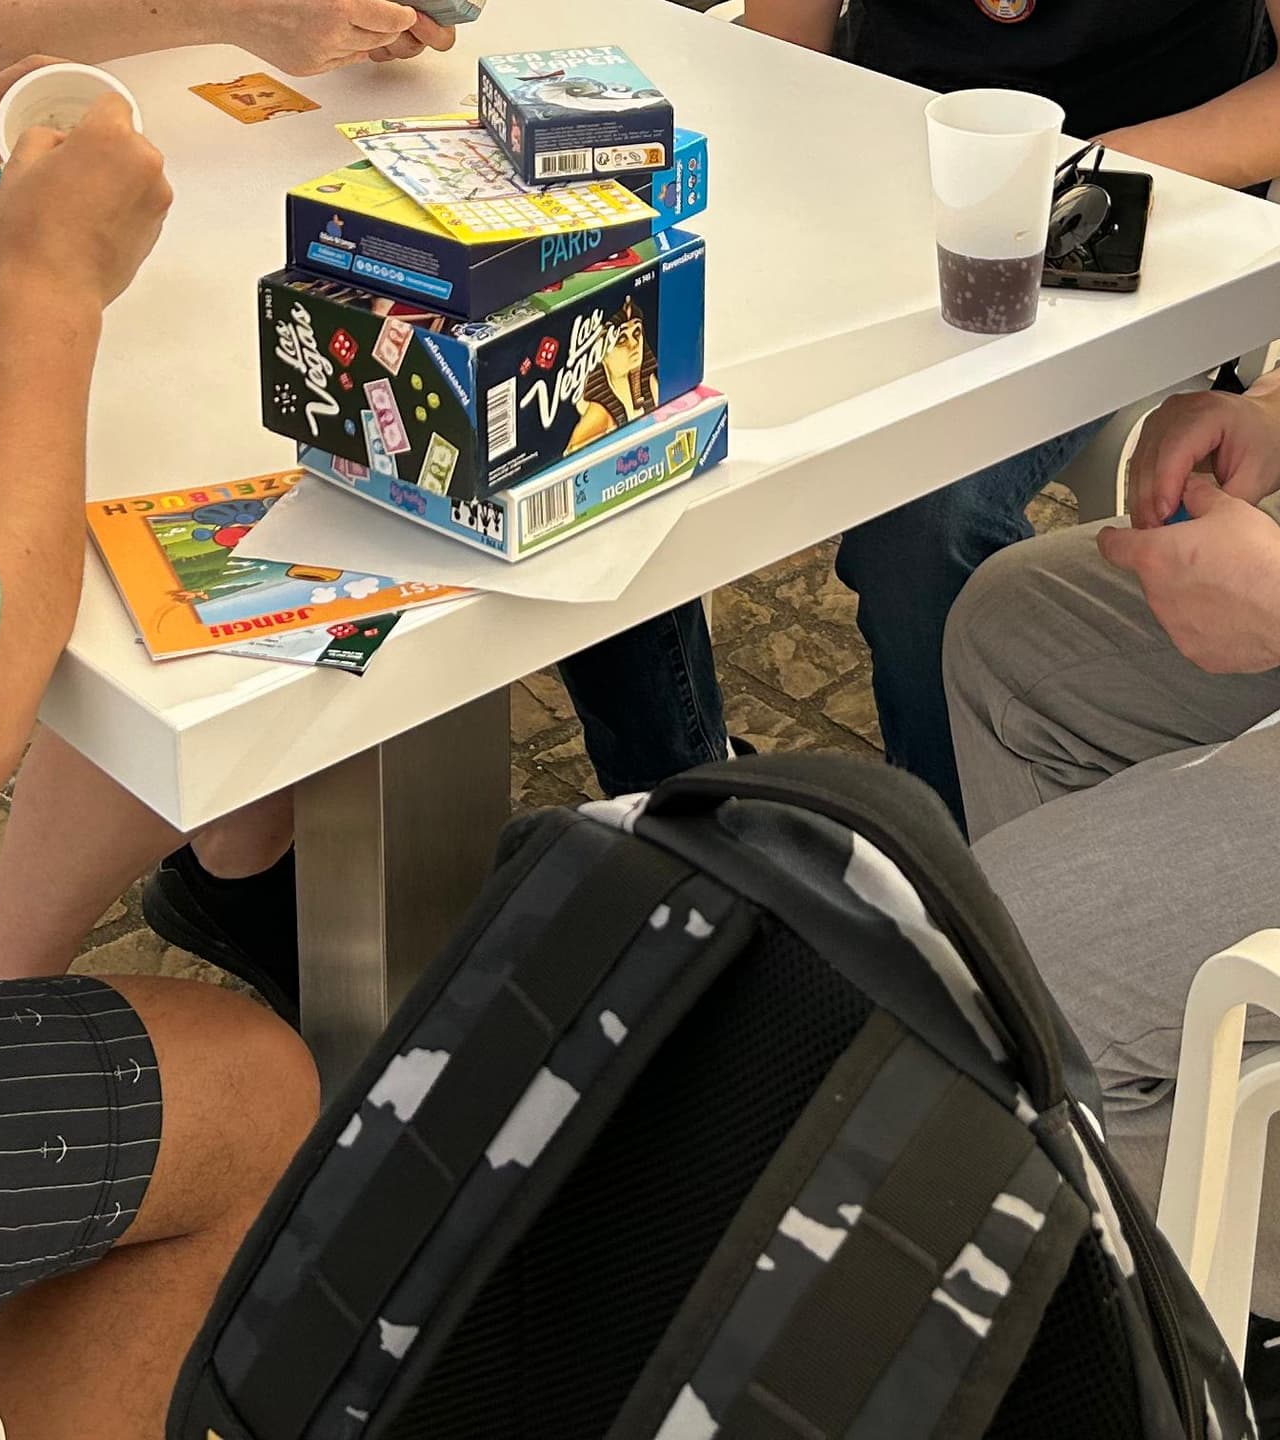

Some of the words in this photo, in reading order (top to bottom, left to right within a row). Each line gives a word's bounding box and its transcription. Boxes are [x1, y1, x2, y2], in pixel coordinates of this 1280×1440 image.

[551, 46, 615, 60] SALT
[540, 228, 602, 273] PARIS
[662, 246, 705, 273] Ravensburger
[275, 319, 308, 374] Las
[566, 309, 604, 367] Las
[291, 301, 341, 437] Vegas
[424, 336, 471, 406] Ravensburger
[520, 324, 622, 429] Vegas
[601, 460, 665, 502] memory
